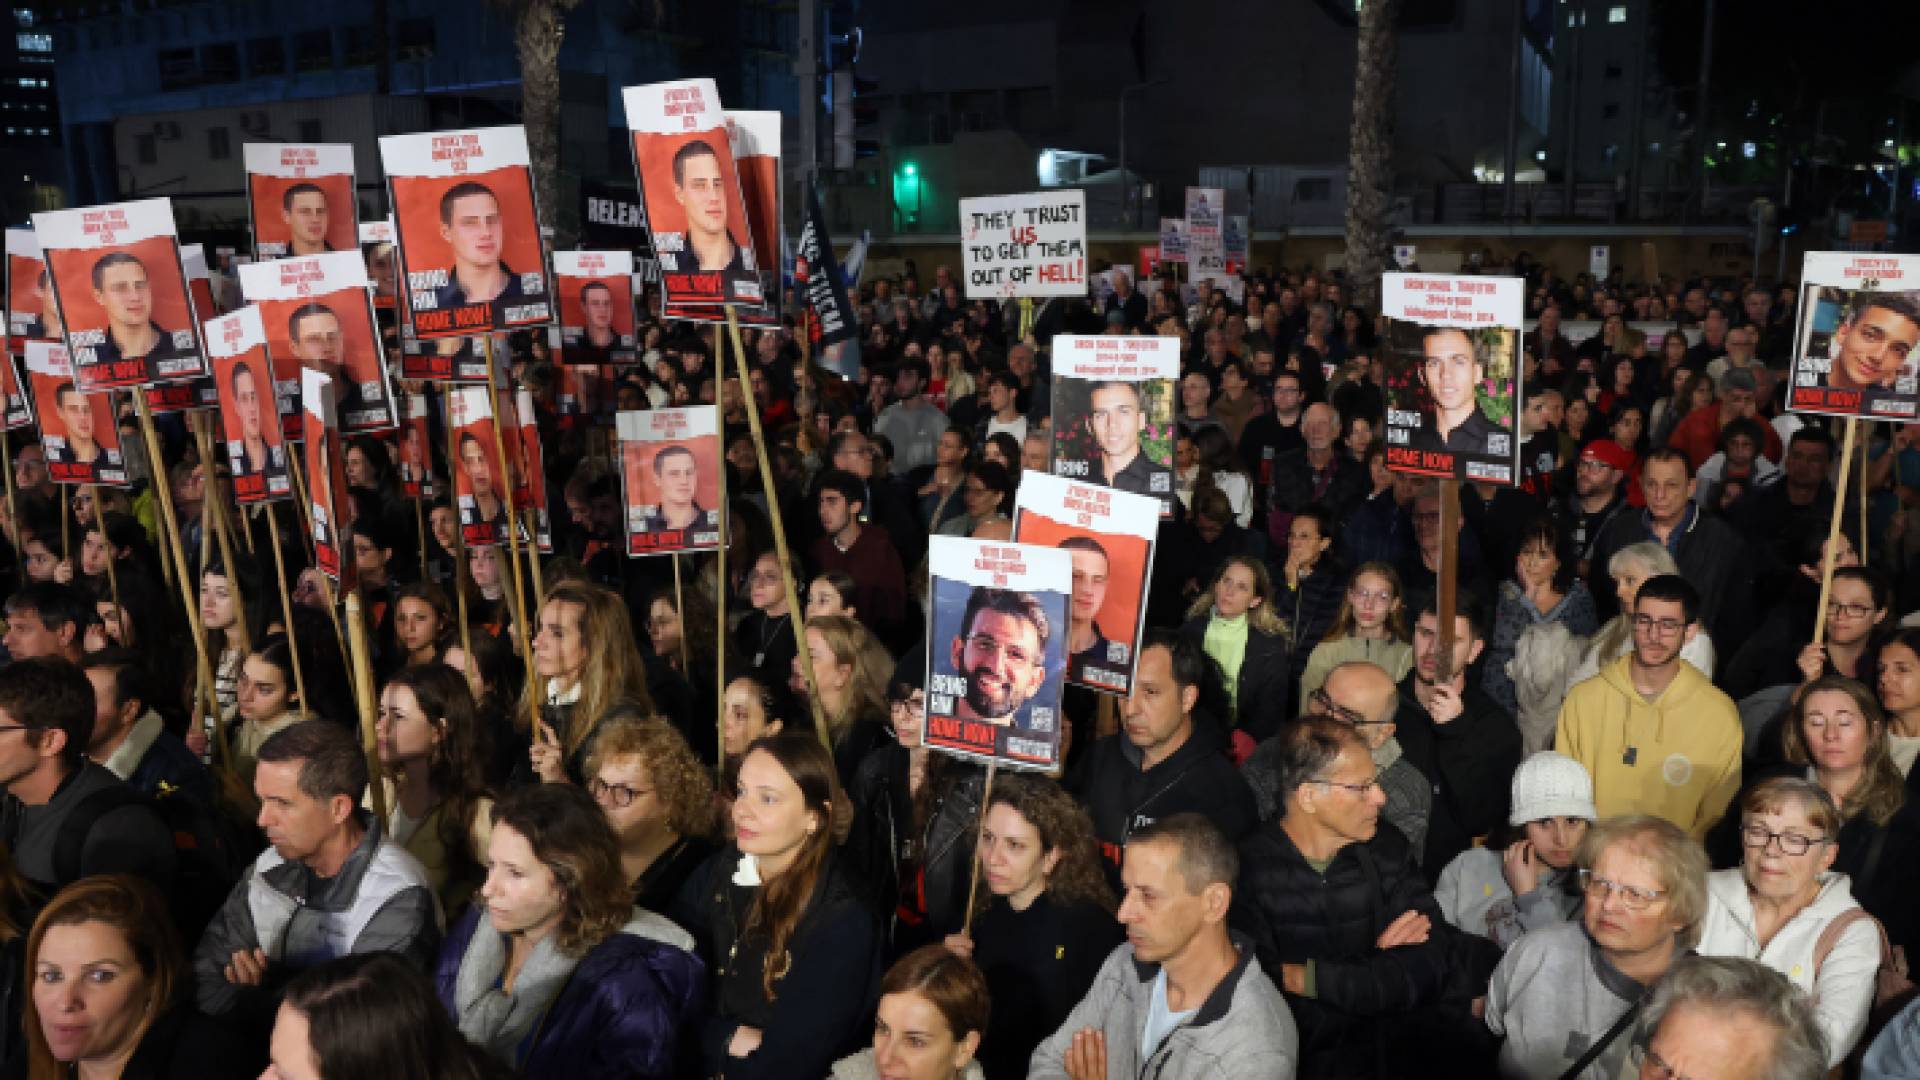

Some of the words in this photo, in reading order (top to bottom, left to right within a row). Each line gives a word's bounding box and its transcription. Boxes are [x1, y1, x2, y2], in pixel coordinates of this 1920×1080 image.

[588, 196, 647, 228] RELEA
[971, 210, 1016, 230] THEY
[1023, 203, 1081, 224] TRUST
[1010, 226, 1038, 244] US
[970, 245, 994, 262] TO
[998, 242, 1032, 260] GET
[1037, 240, 1083, 257] THEM
[971, 267, 1004, 286] OUT
[1009, 266, 1033, 284] OF
[1038, 258, 1084, 284] HELL!
[415, 310, 449, 330] HOME
[455, 303, 493, 327] NOW!
[1387, 448, 1420, 465] HOME
[1422, 452, 1455, 471] NOW!
[928, 716, 962, 738] HOME
[963, 721, 997, 744] NOW!
